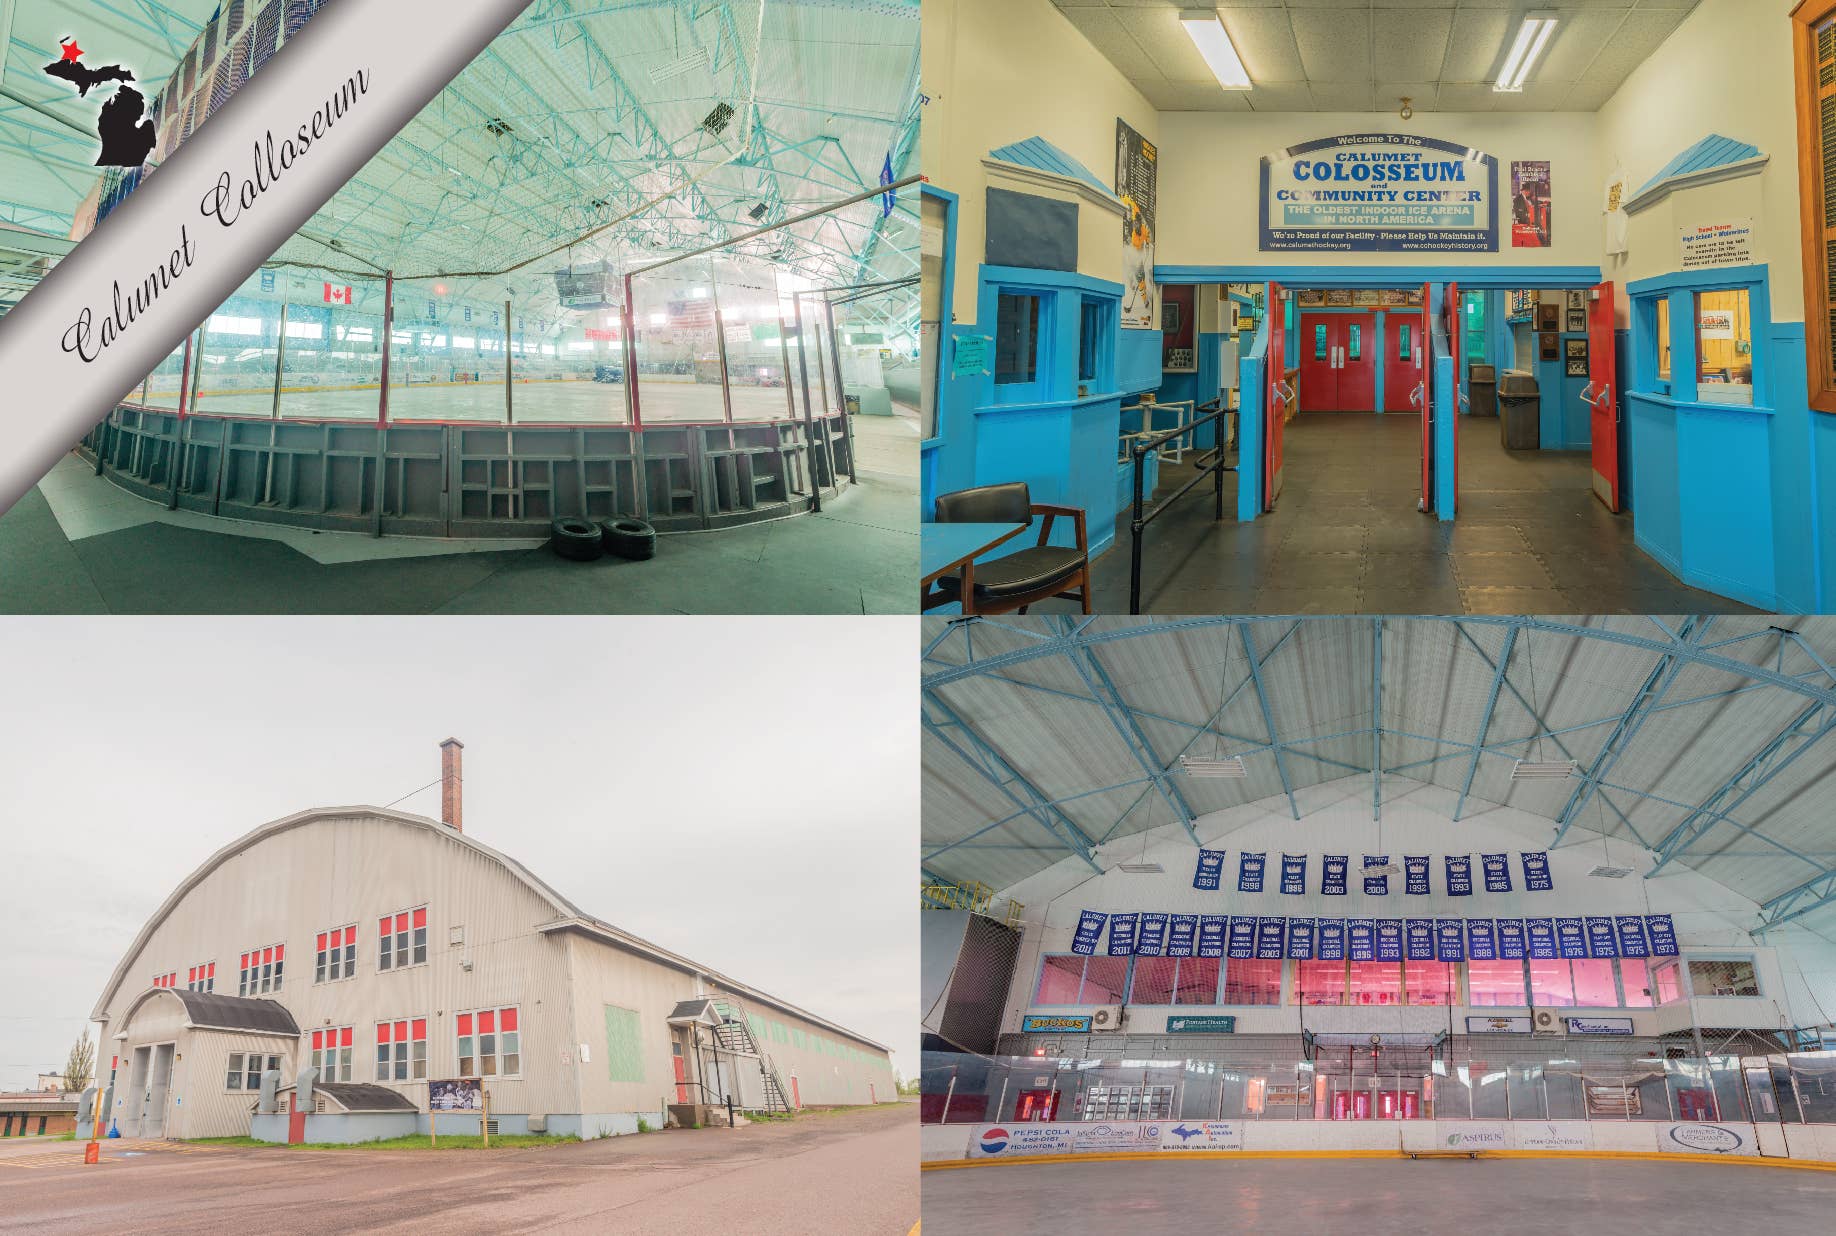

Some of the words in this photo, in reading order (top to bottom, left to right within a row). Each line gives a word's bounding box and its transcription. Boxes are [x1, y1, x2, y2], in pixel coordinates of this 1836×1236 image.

[1337, 135, 1384, 146] Welcome
[1387, 135, 1400, 144] To
[1401, 135, 1421, 146] The
[1335, 152, 1422, 162] CALUMET
[1293, 160, 1466, 182] COLOSSEUM
[1287, 205, 1311, 215] THE
[1314, 205, 1359, 215] OLDEST
[1361, 205, 1406, 215] INDOOR
[1408, 206, 1428, 215] ICE
[1431, 206, 1470, 215] ARENA
[1323, 215, 1336, 224] IN
[1339, 215, 1379, 224] NORTH
[1381, 215, 1435, 224] AMERICA
[1272, 231, 1295, 240] We're
[1297, 231, 1320, 239] Proud
[1321, 231, 1330, 239] of
[1346, 231, 1376, 241] Facility
[1380, 231, 1406, 240] Please
[1407, 231, 1426, 241] Help
[1428, 232, 1438, 240] Us
[1440, 231, 1475, 240] Maintain
[1477, 231, 1486, 240] it.
[1695, 233, 1713, 241] School
[1269, 241, 1351, 250] www.calumethockey.org
[1402, 241, 1488, 250] www.cchockeyhistory.org
[1198, 878, 1216, 887] 1991
[1241, 881, 1260, 890] 1998
[1489, 882, 1508, 890] 1985
[1530, 880, 1549, 889] 1975
[1324, 886, 1344, 894] 2003
[1409, 884, 1427, 892] 1992
[1451, 884, 1469, 892] 1993
[1073, 944, 1091, 954] 2011
[1112, 946, 1130, 955] 2011
[1139, 946, 1160, 955] 2010
[1291, 949, 1309, 958] 2001
[1381, 949, 1400, 958] 1993
[1411, 949, 1431, 957] 1992
[1474, 949, 1492, 957] 1988
[1534, 949, 1553, 957] 1985
[1564, 948, 1584, 956] 1976
[1595, 947, 1615, 956] 1975
[1626, 946, 1645, 955] 1975
[1656, 945, 1675, 954] 1973
[1260, 950, 1280, 958] 2003
[1322, 950, 1341, 959] 1998
[1353, 951, 1372, 959] 1996
[1442, 950, 1461, 958] 1991
[1462, 1132, 1502, 1142] ASPIRUS
